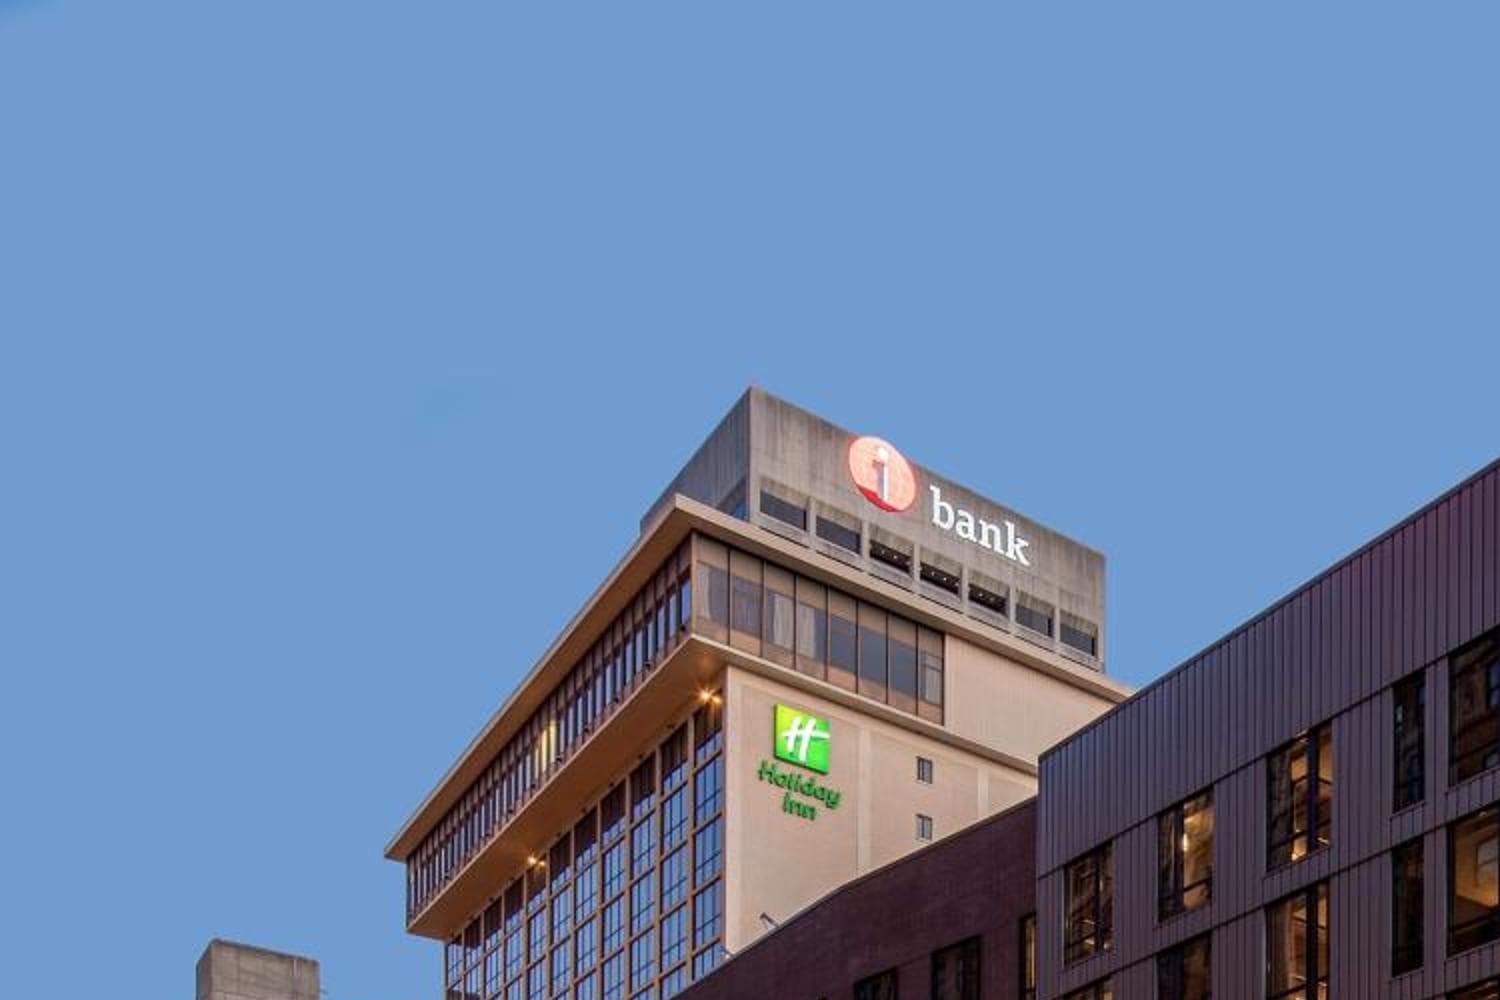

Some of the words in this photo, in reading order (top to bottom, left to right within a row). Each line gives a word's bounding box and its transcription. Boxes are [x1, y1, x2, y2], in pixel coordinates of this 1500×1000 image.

[929, 484, 1031, 567] bank
[758, 758, 840, 809] Holiday
[782, 792, 816, 821] Inn
